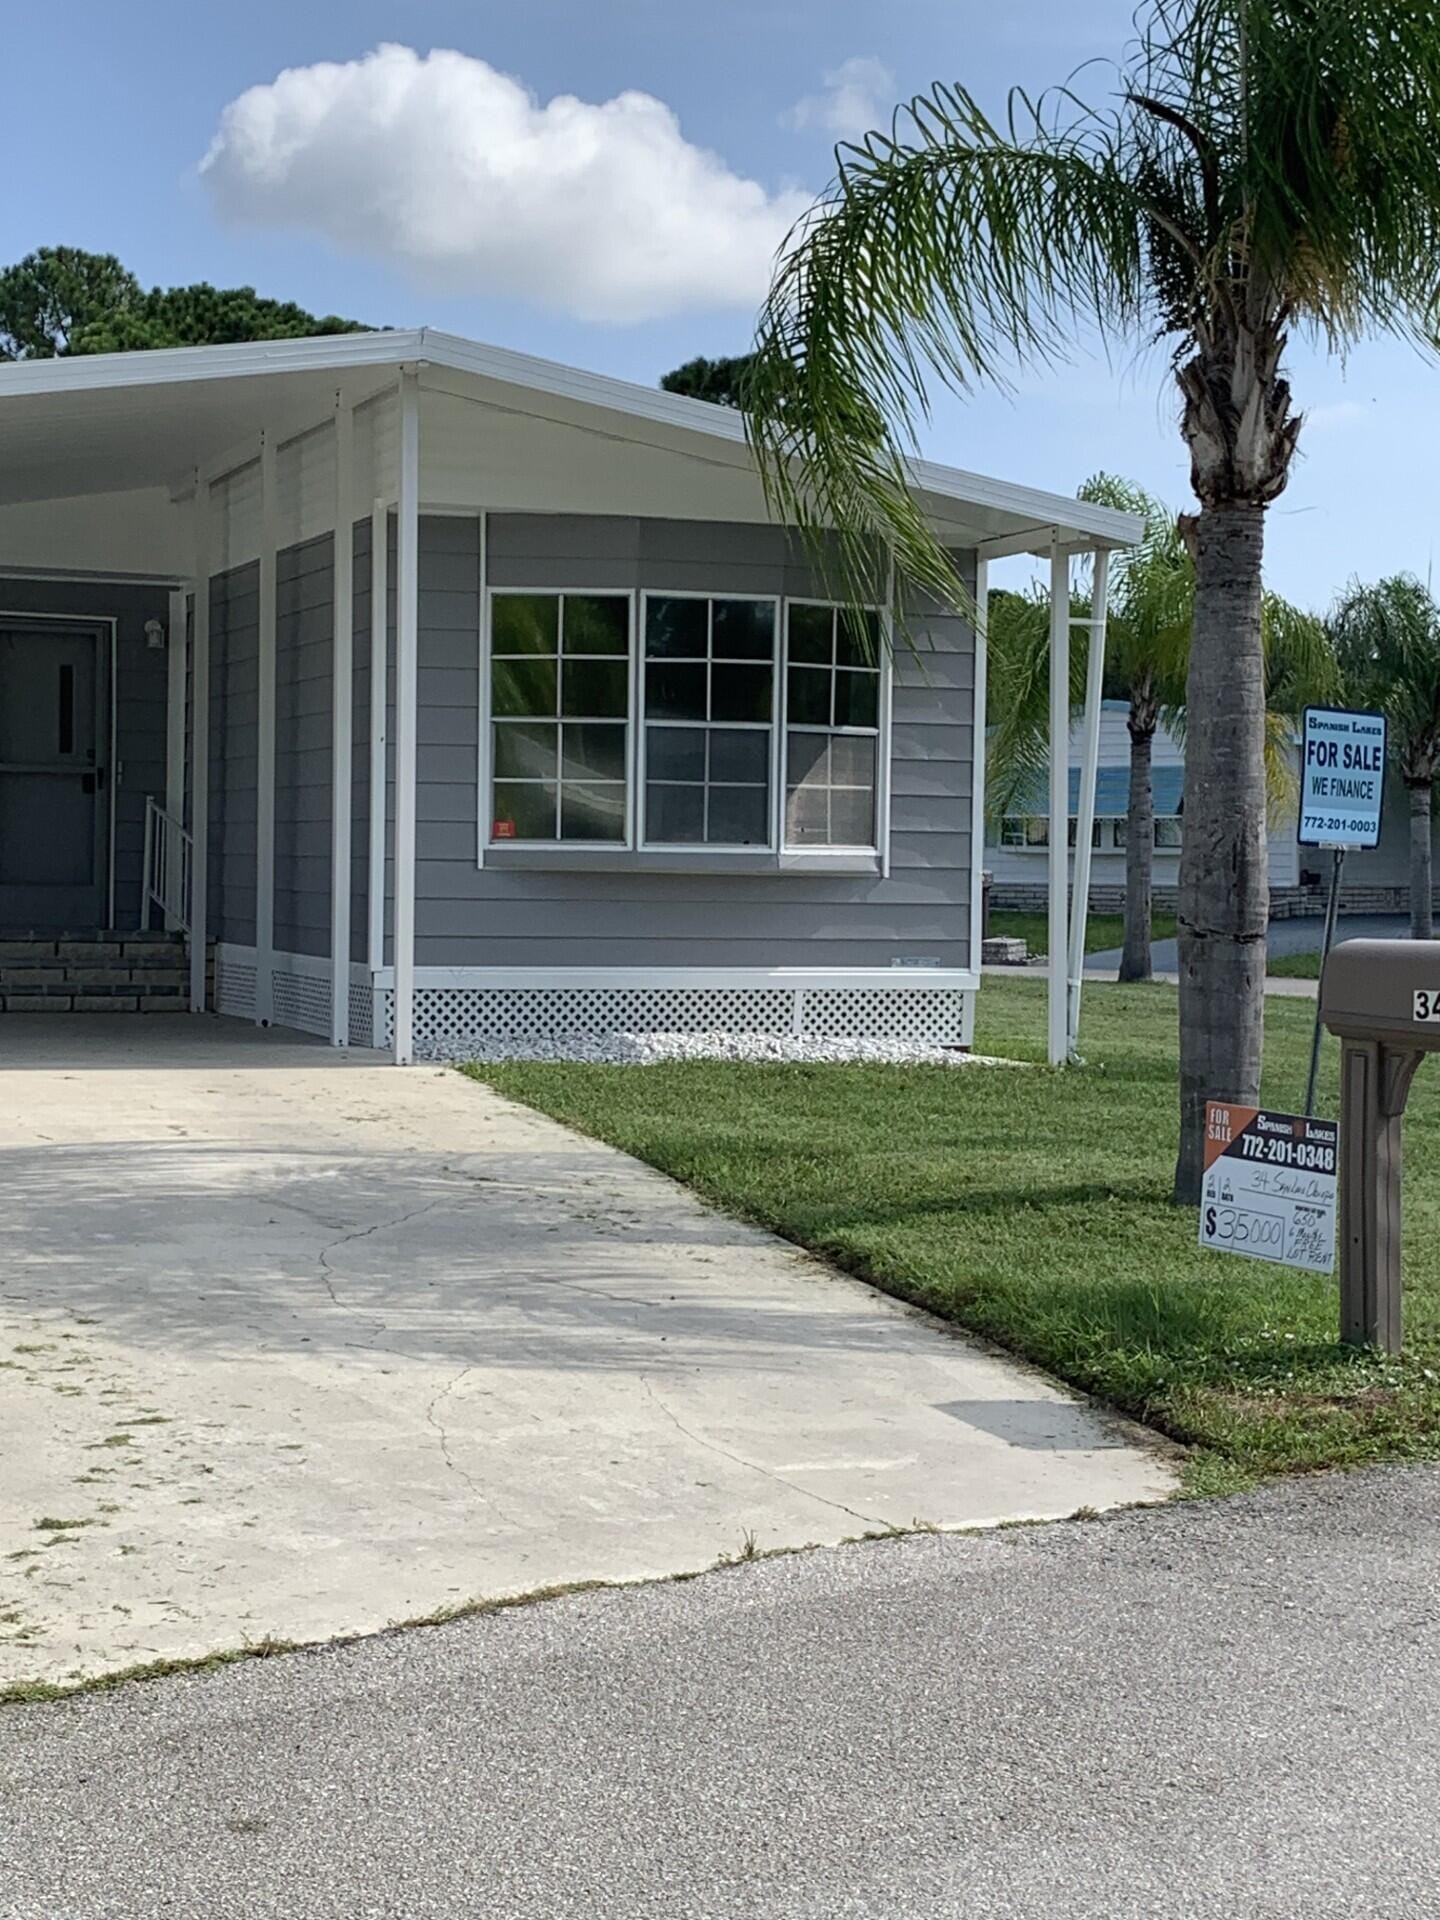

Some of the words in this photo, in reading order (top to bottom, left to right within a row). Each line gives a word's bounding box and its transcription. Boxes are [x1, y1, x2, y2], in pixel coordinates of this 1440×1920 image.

[1308, 717, 1350, 733] SPANISH
[1352, 721, 1382, 736] LAKES
[1307, 740, 1338, 768] FOR
[1343, 744, 1381, 772] SALE
[1312, 776, 1328, 796] WE
[1330, 778, 1374, 800] FINANCE
[1304, 816, 1377, 833] 772-201-0003
[1210, 1108, 1230, 1126] FOR
[1208, 1125, 1232, 1142] SALE
[1257, 1115, 1293, 1135] SPANISH
[1305, 1122, 1336, 1142] LAKES
[1242, 1134, 1334, 1170] 772-201-0348
